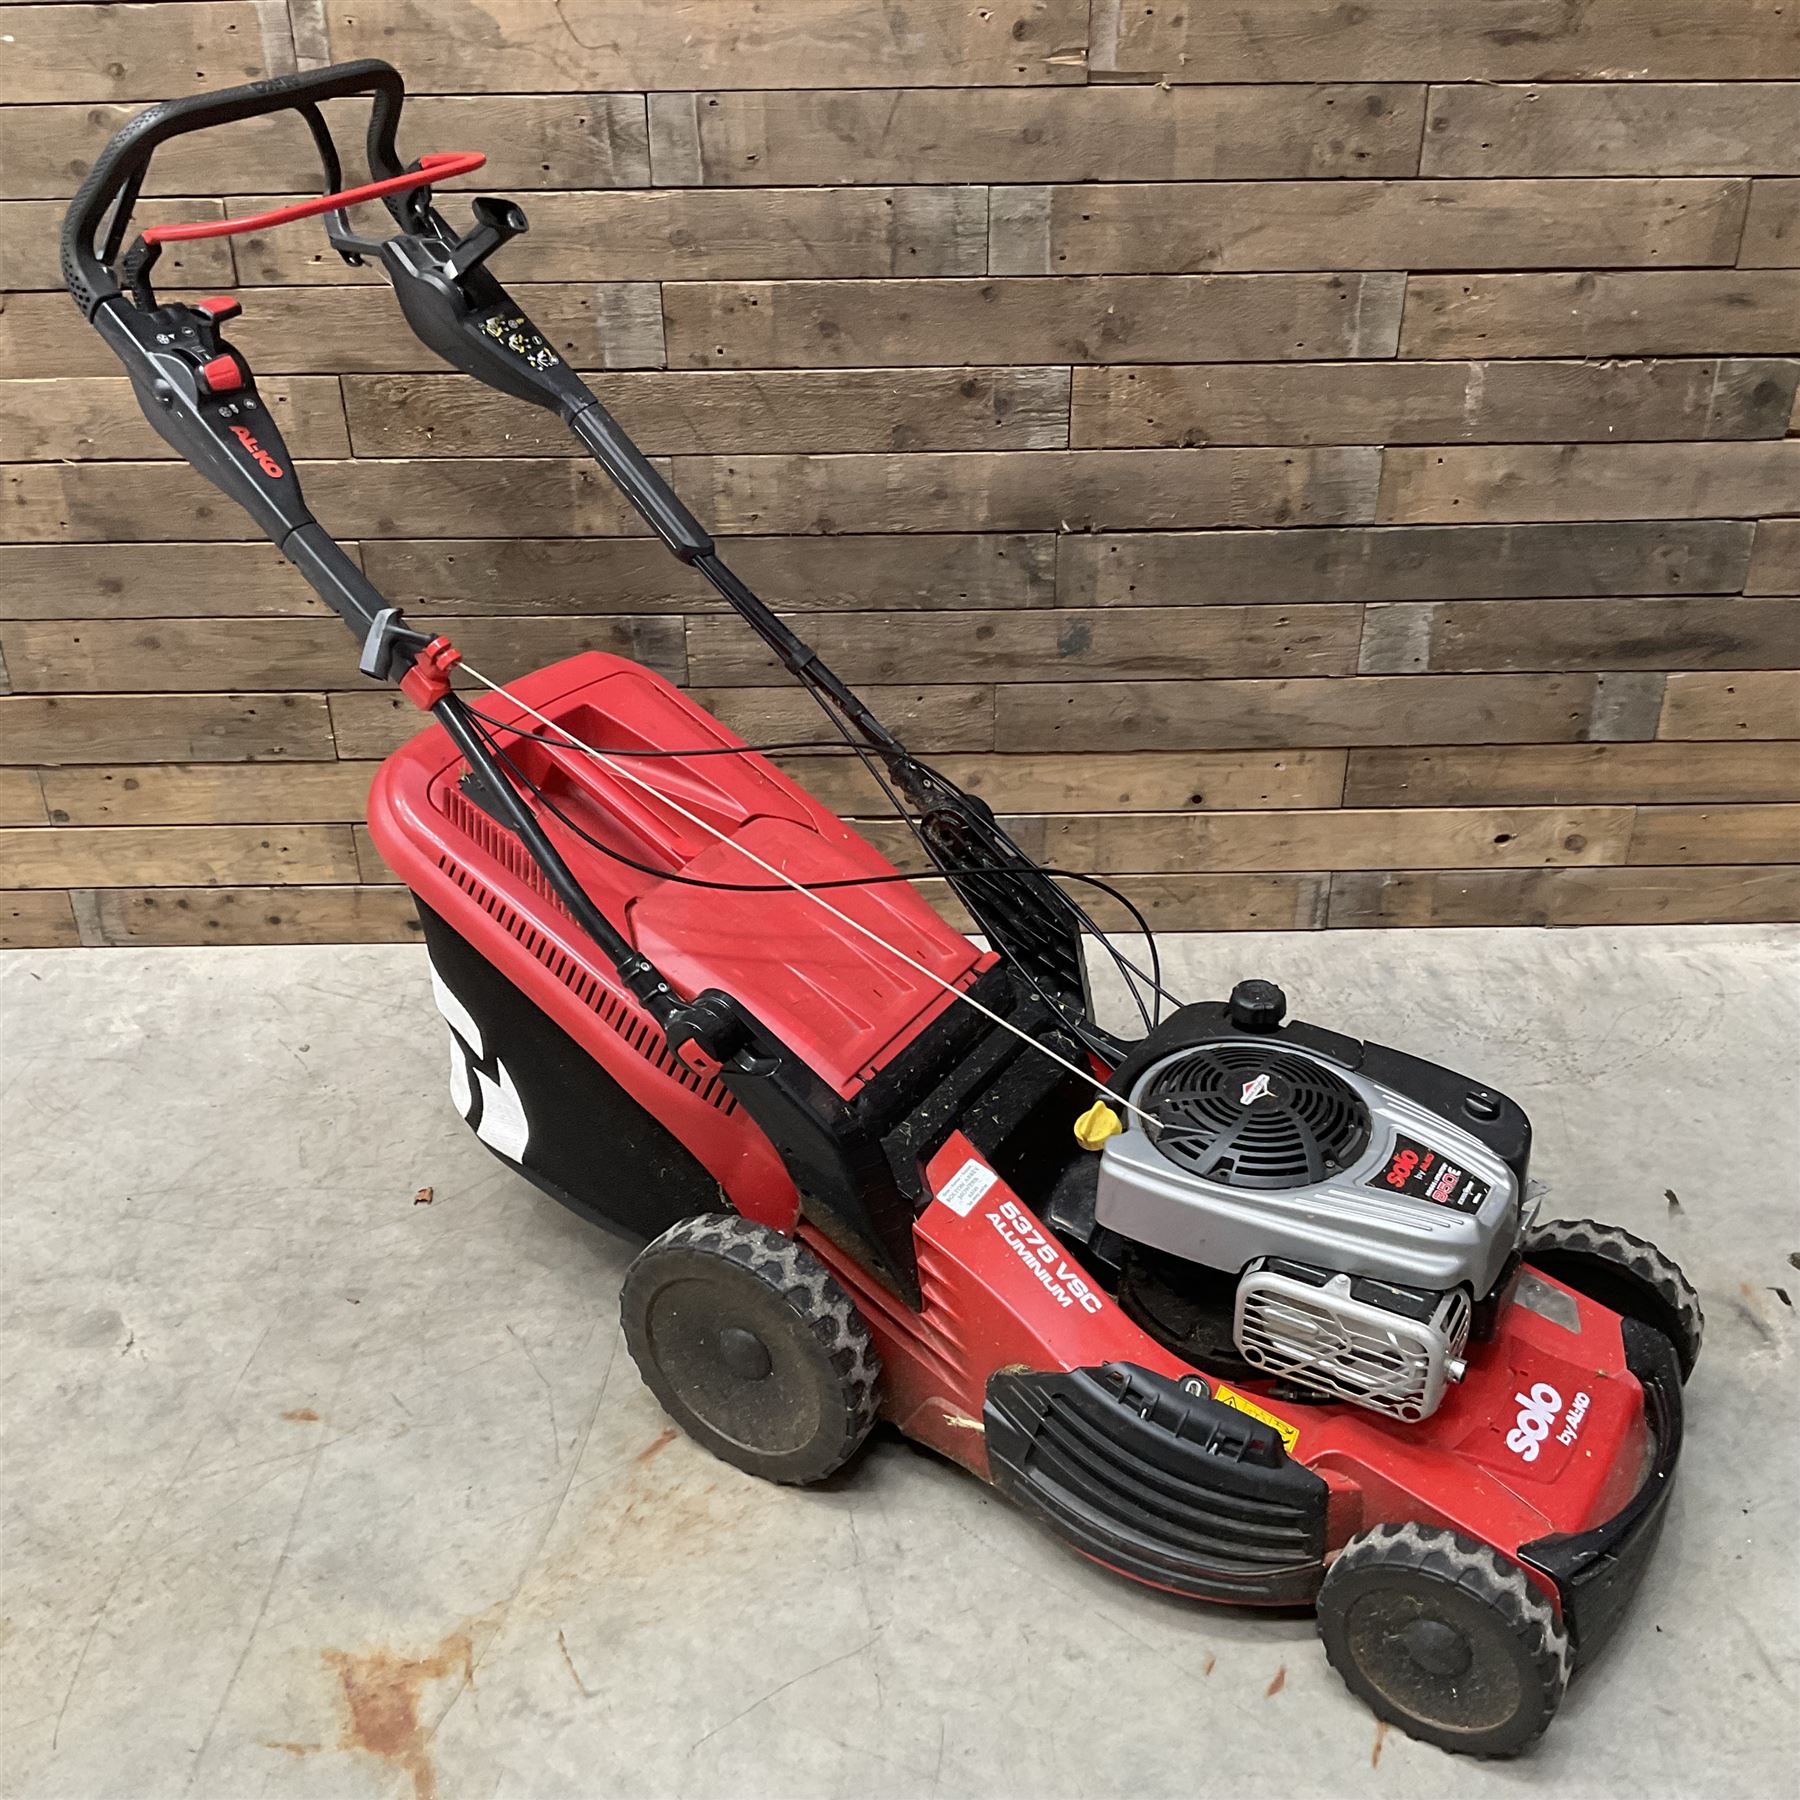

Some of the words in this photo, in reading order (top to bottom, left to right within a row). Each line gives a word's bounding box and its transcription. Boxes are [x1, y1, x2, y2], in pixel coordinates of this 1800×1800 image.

[1387, 1149, 1419, 1188] solo
[1414, 1170, 1426, 1181] by
[985, 1213, 1073, 1308] ALUMINIUM
[999, 1201, 1059, 1264] 5375
[1056, 1261, 1102, 1313] VSC
[1506, 1383, 1562, 1462] solo
[1556, 1424, 1578, 1446] by
